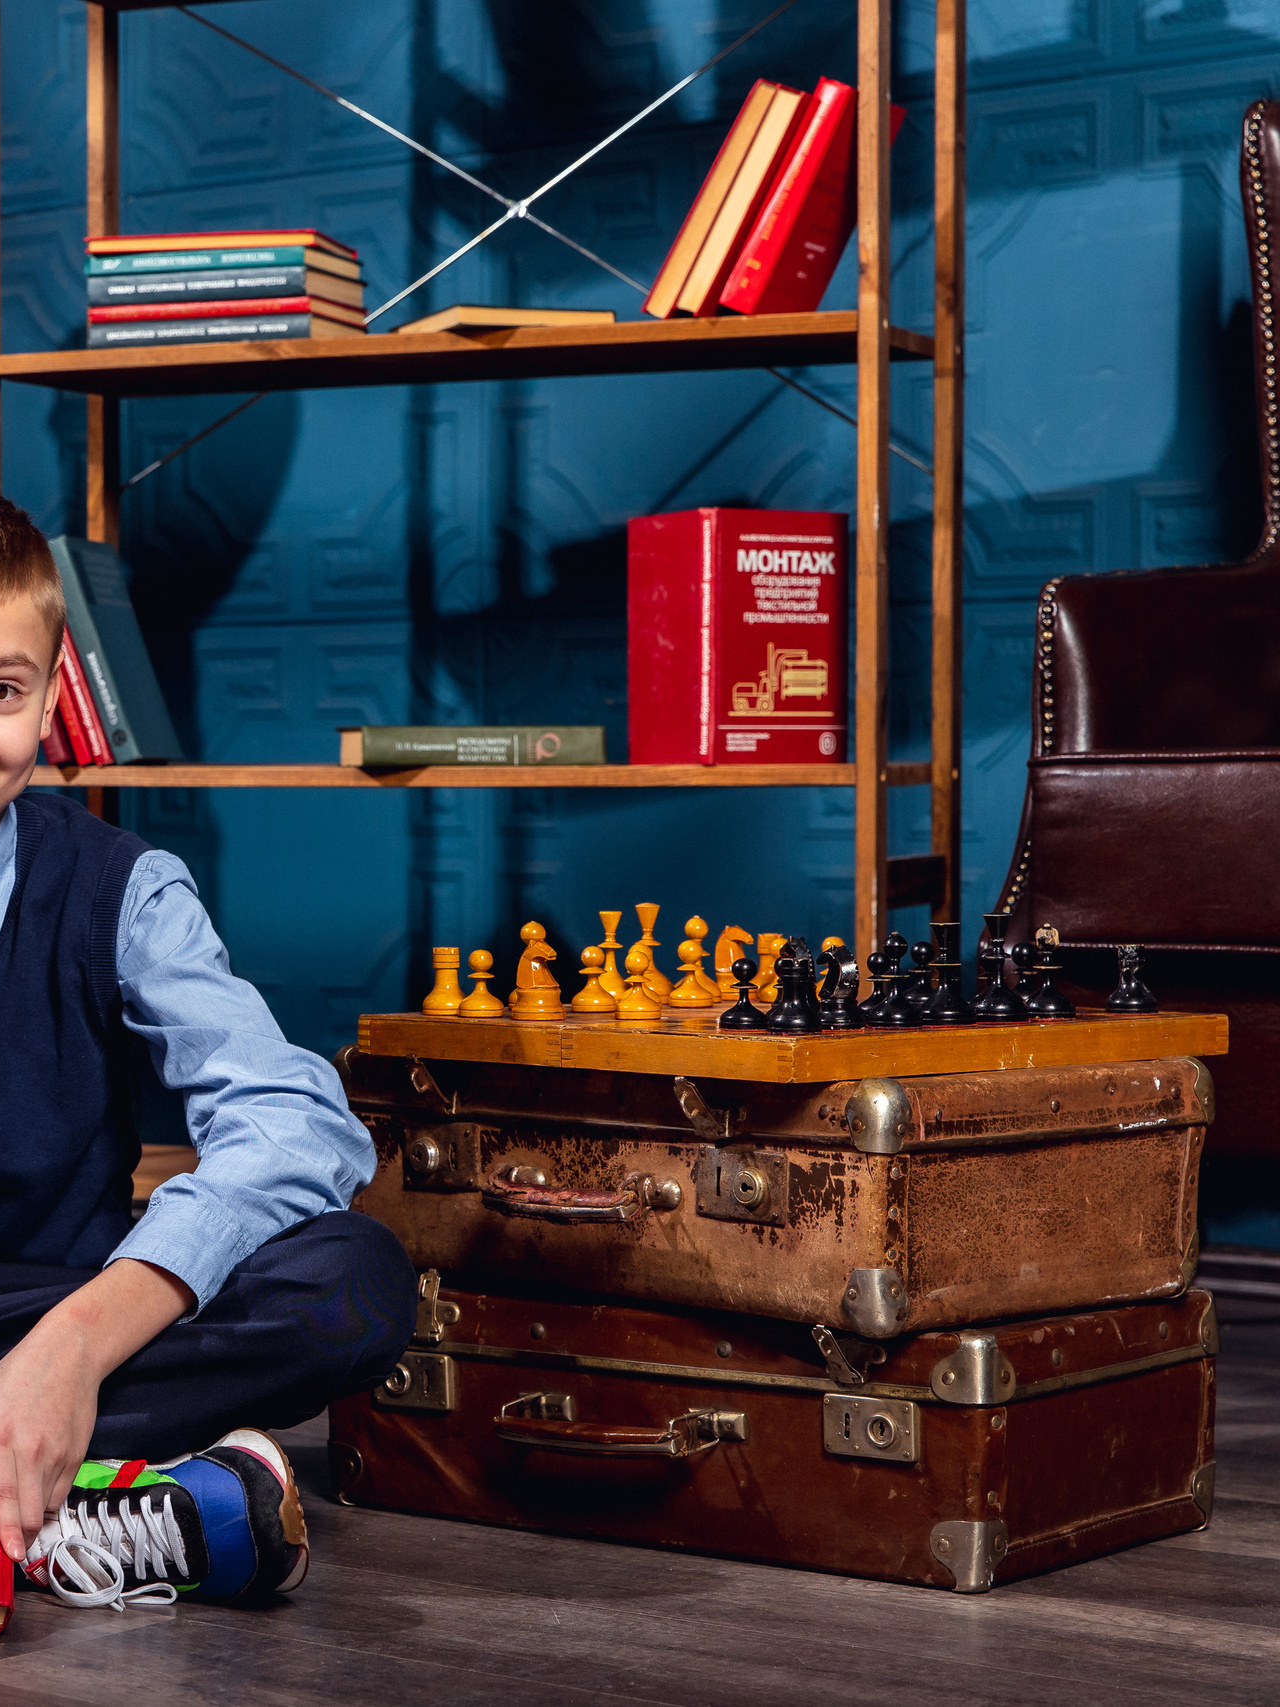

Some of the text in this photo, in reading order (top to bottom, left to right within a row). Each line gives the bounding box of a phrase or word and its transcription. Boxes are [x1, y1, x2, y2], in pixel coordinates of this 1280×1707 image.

[737, 549, 836, 574] МОНТАЖ
[751, 574, 821, 588] оборудования
[754, 587, 819, 599] предприятий
[756, 600, 818, 611] текстильной
[742, 612, 830, 625] промышленности
